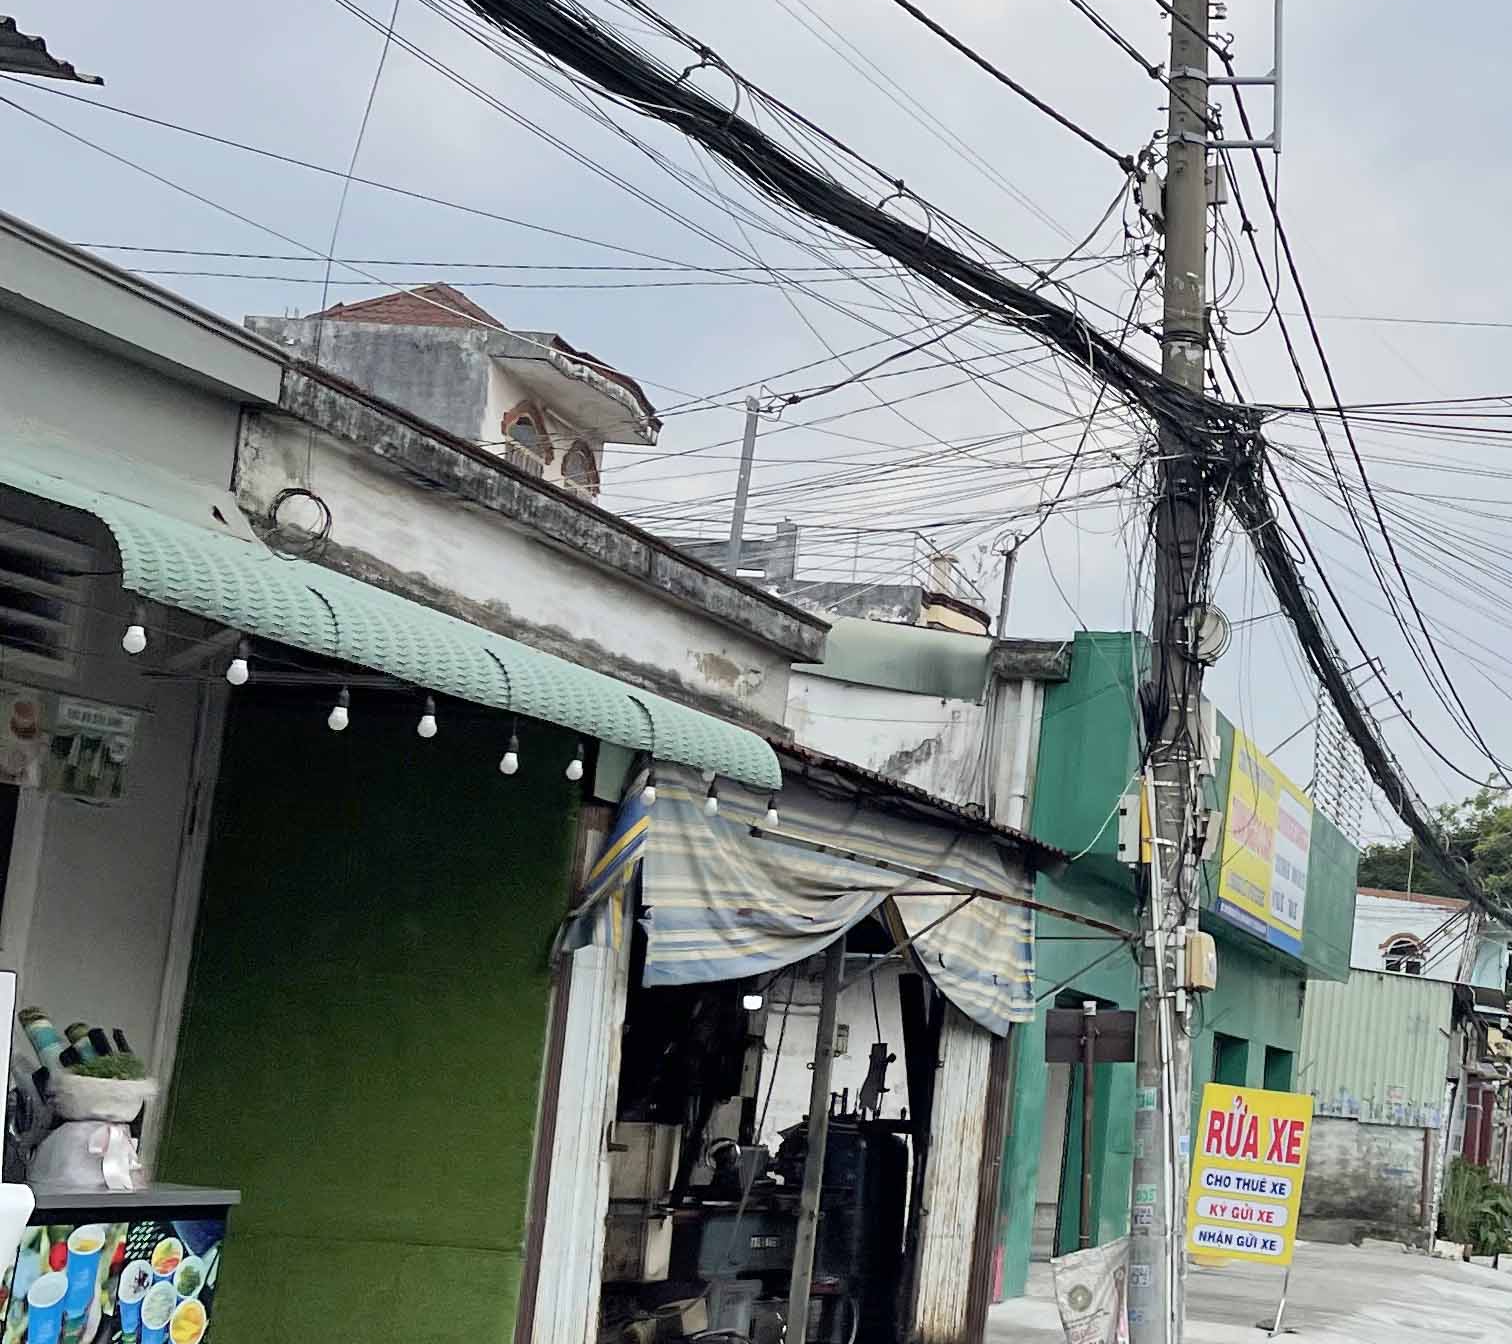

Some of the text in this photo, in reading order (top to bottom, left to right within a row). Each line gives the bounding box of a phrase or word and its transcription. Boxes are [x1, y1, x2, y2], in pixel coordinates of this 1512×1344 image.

[1204, 1095, 1305, 1165] RỬA XE
[1206, 1173, 1287, 1196] CHO THUÊ XE
[1257, 1209, 1275, 1224] XE
[1198, 1229, 1233, 1247] NHẬN
[1260, 1238, 1278, 1252] XE
